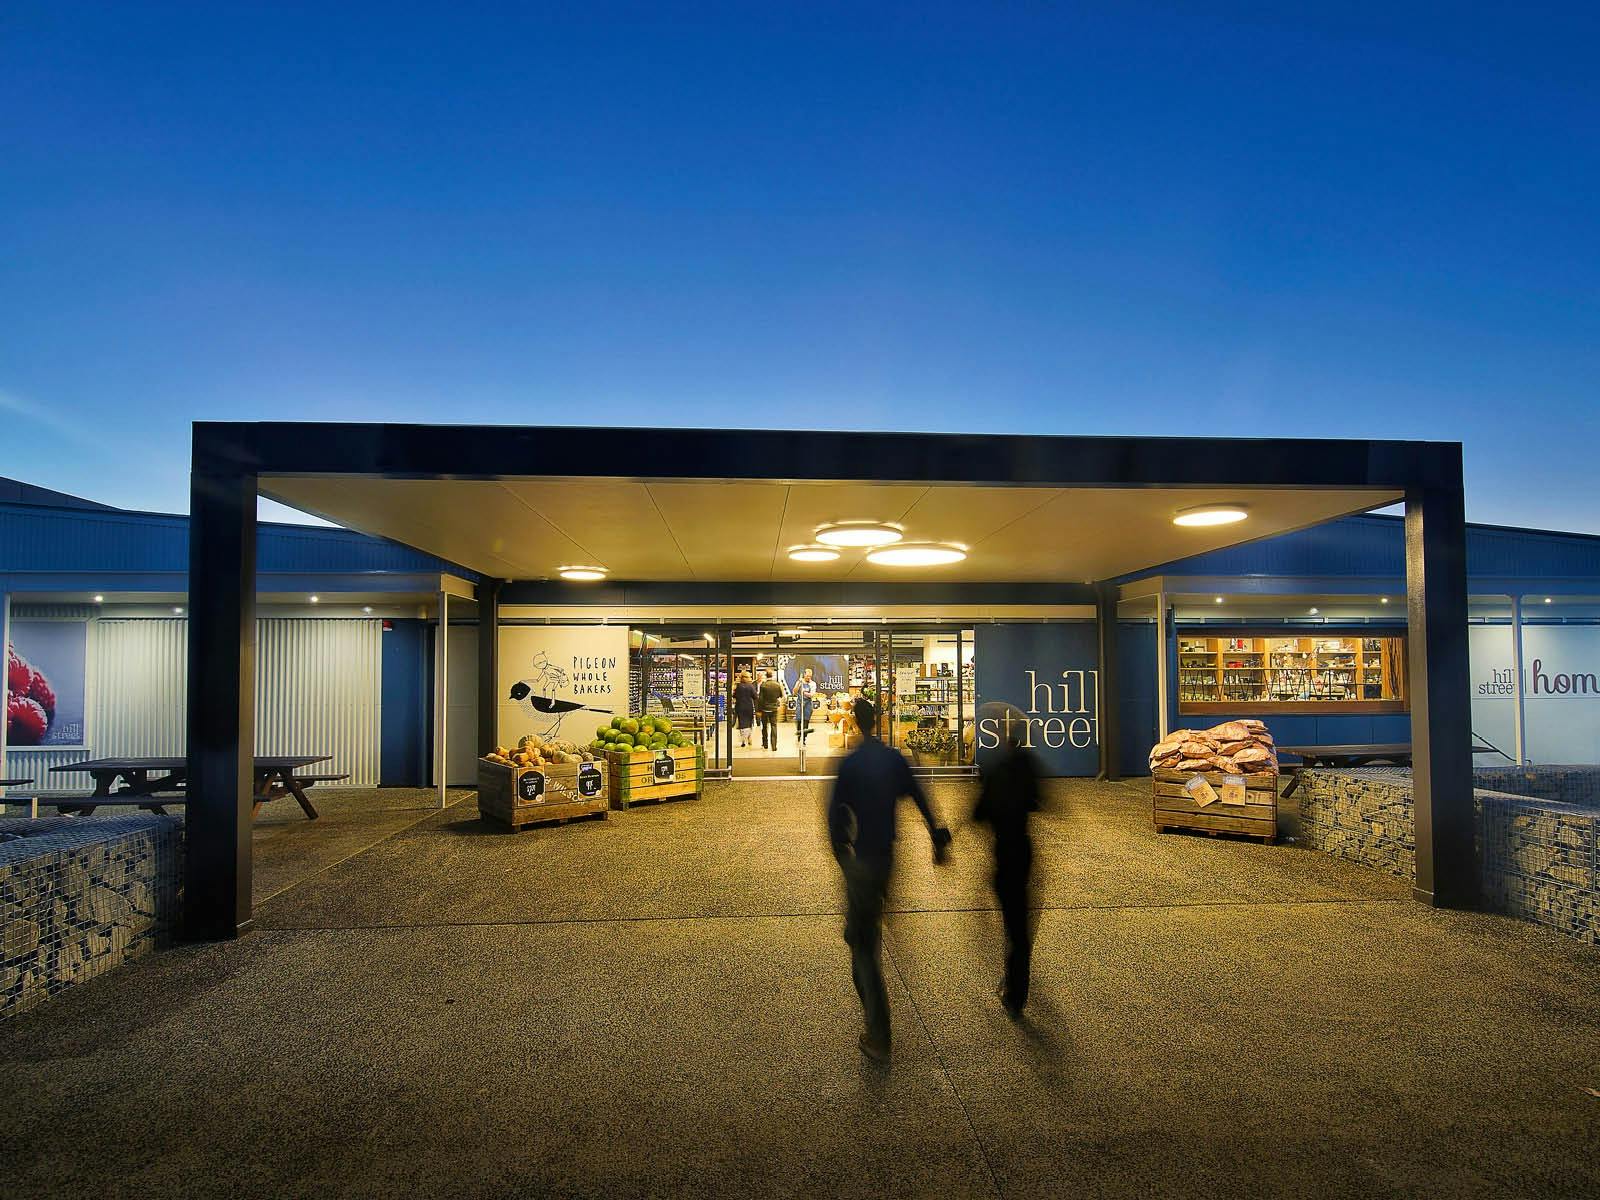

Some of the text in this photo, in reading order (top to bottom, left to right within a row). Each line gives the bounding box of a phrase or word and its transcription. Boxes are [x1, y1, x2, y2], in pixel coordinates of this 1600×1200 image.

[573, 656, 616, 669] PIGEON
[573, 672, 607, 681] WHOLE
[828, 675, 843, 684] hill
[1492, 669, 1514, 683] hil
[1532, 659, 1600, 694] hom
[573, 684, 612, 694] BAKERS
[1025, 670, 1098, 713] hill
[1478, 681, 1515, 694] stree
